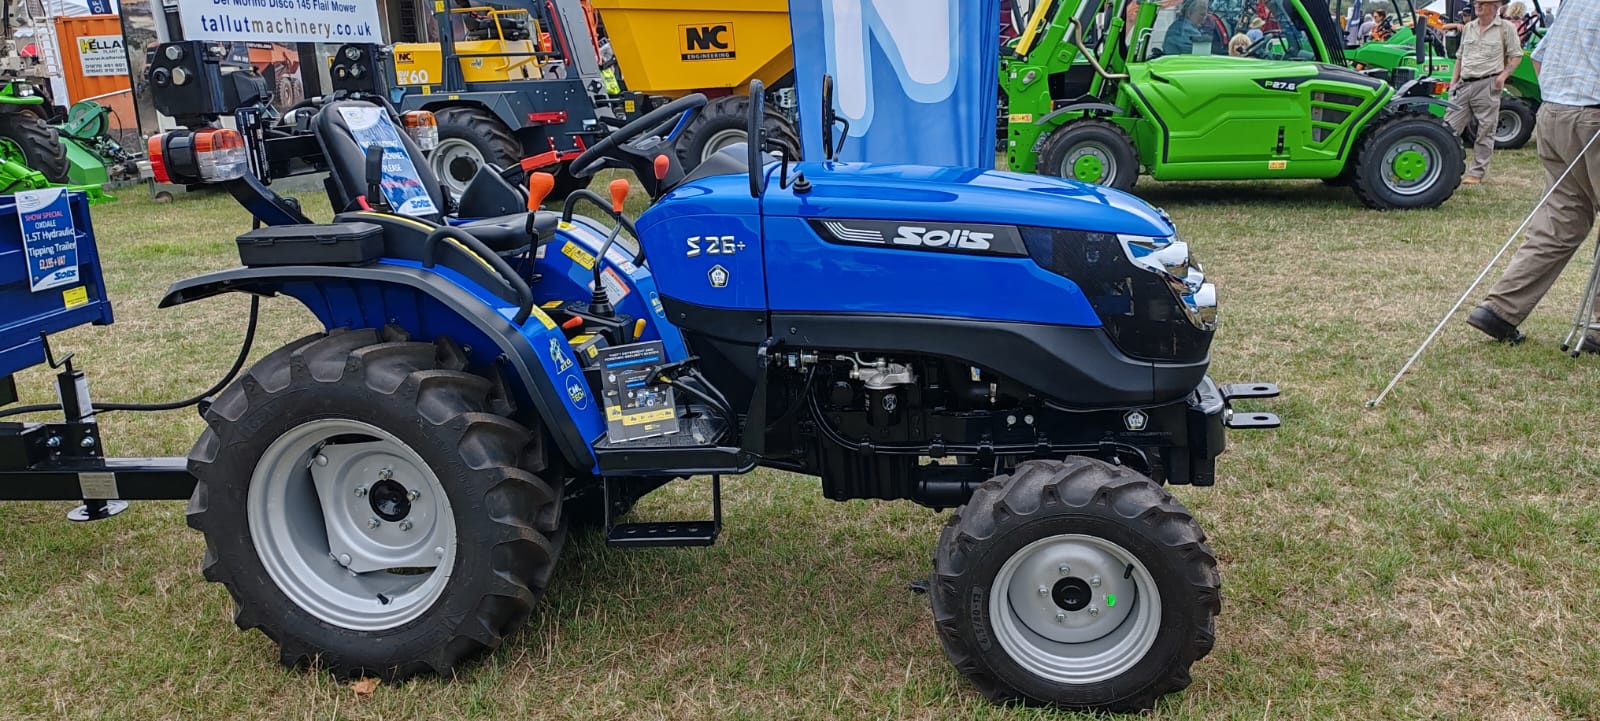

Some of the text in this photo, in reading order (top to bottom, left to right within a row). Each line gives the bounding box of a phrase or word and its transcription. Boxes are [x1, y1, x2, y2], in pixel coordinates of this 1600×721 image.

[268, 0, 294, 9] Disco
[297, 0, 311, 10] 145
[313, 0, 330, 11] Flail
[331, 1, 357, 13] Mower
[201, 14, 372, 38] tallutmachinery.co.uk
[686, 25, 729, 51] NC
[80, 38, 126, 54] KELLA
[398, 52, 411, 60] NC
[687, 52, 731, 60] ENGINEERING
[411, 69, 428, 84] 60
[1265, 80, 1296, 90] P27.6
[24, 210, 63, 222] SHOW SPECIAL
[34, 219, 56, 229] OXDALE
[42, 226, 74, 241] Hydraulic
[28, 241, 77, 257] Tipping Trailer
